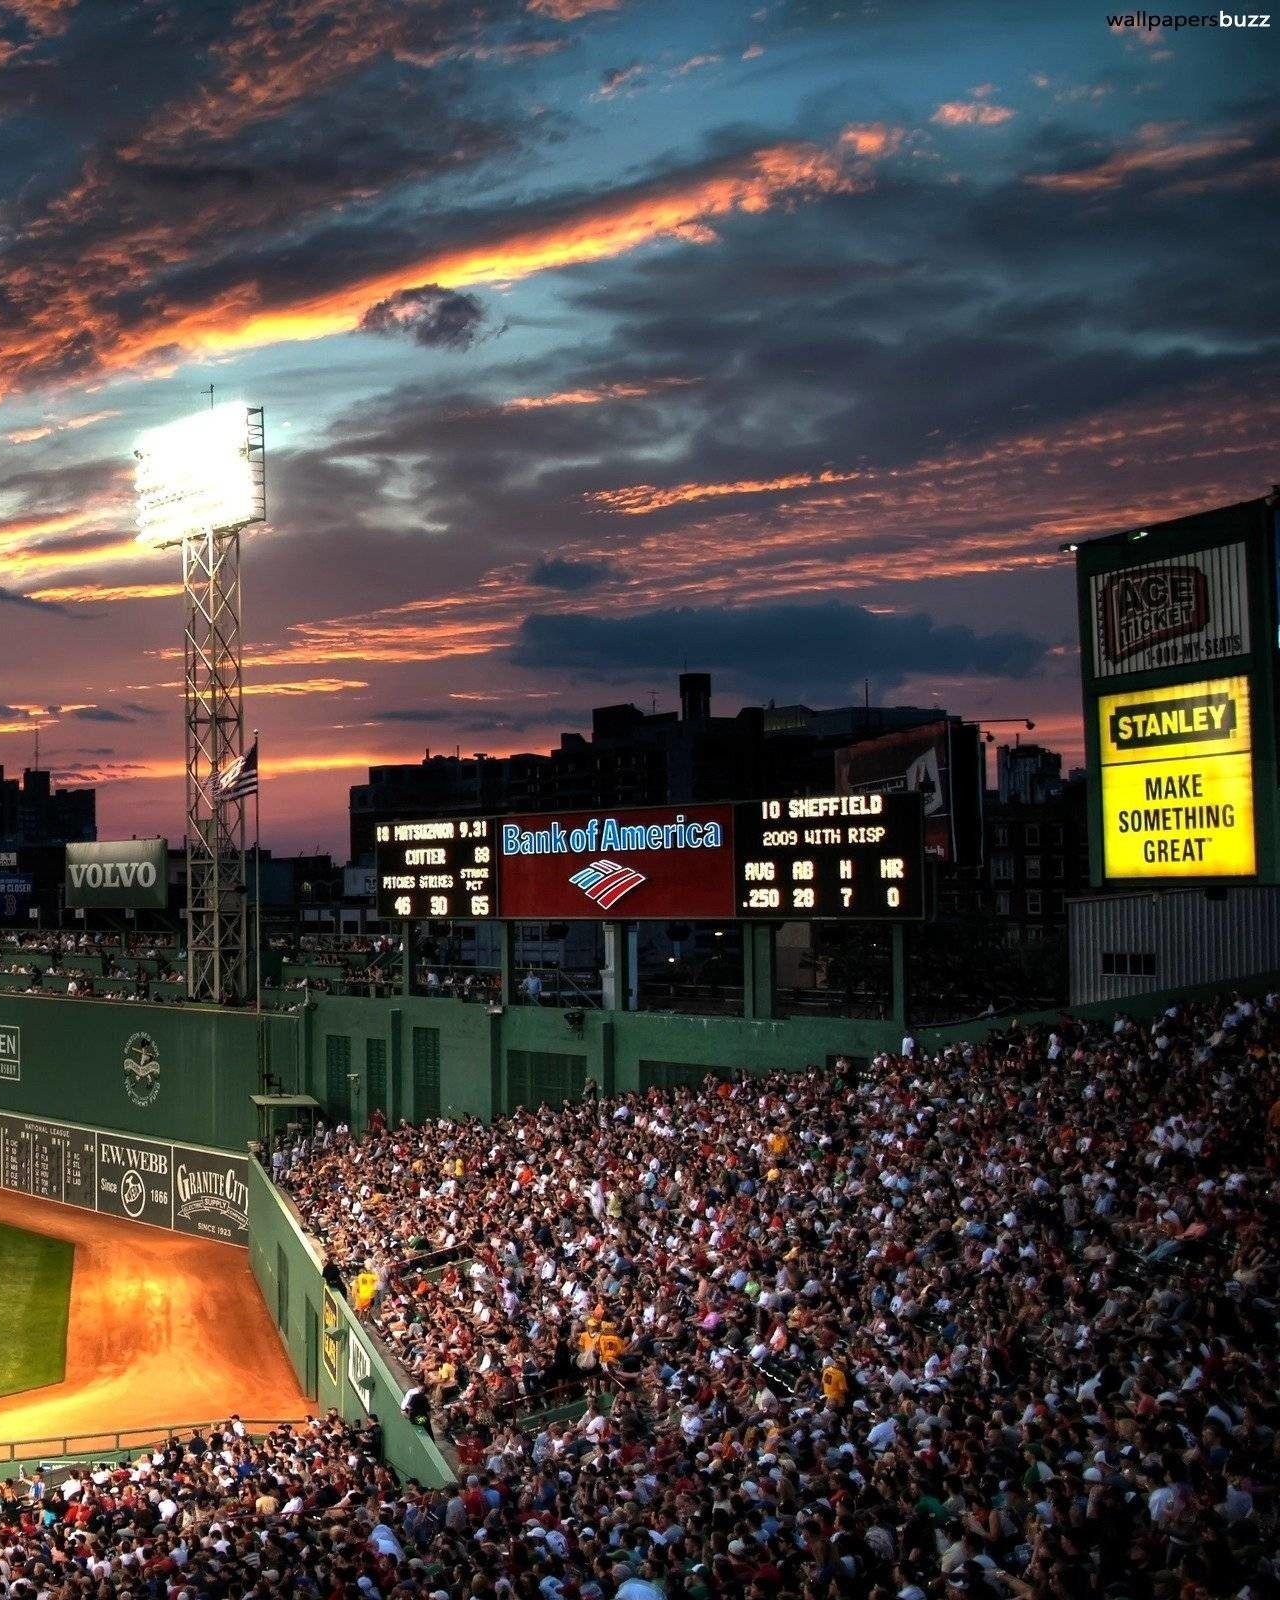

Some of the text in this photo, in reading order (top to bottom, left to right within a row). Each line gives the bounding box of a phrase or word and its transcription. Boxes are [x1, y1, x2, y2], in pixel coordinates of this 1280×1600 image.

[1119, 573, 1195, 612] ACE
[1120, 607, 1193, 646] TICKET
[1118, 703, 1226, 740] STANLEY
[1144, 773, 1203, 801] MAKE
[761, 794, 883, 820] 10 SHEFFIELD
[1118, 803, 1235, 833] SOMETHING
[502, 814, 721, 855] Bank of America
[762, 826, 886, 847] 2009 WITH RISP
[405, 848, 446, 866] CUTTER
[744, 858, 904, 881] AVG AB H HR
[67, 861, 157, 888] VOLVO
[418, 875, 454, 889] STRIKES
[394, 896, 411, 916] 46
[471, 895, 489, 916] 65
[742, 886, 900, 908] .250 28 7 0
[125, 1148, 168, 1175] WEBB
[100, 1177, 118, 1194] Since
[177, 1163, 225, 1203] GRANITE
[150, 1189, 168, 1205] 1866
[197, 1222, 232, 1237] SINCE 1923
